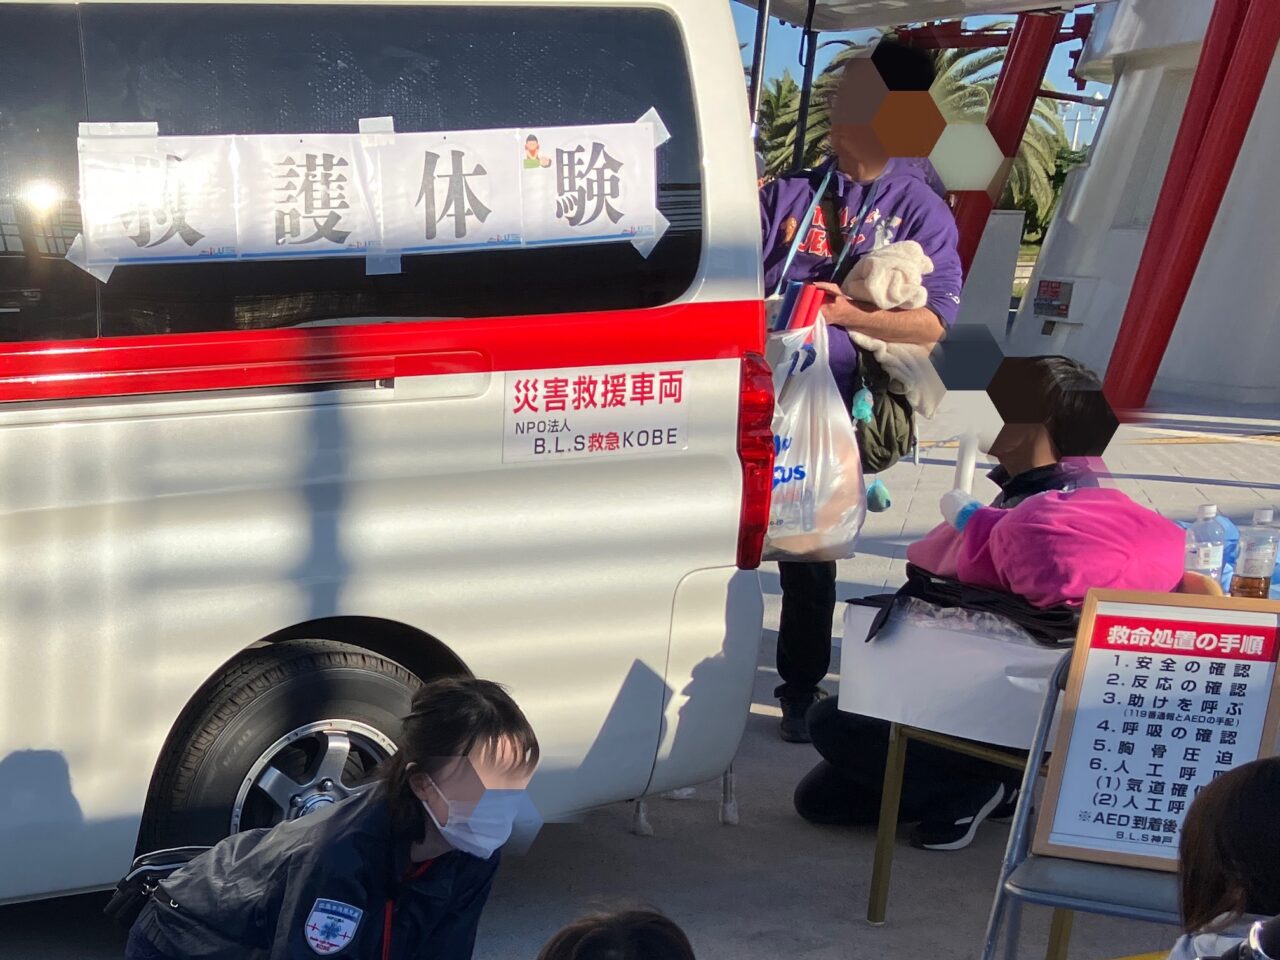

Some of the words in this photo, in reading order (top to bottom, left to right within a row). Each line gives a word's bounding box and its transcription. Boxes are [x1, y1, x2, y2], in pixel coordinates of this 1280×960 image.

[513, 369, 684, 414] 災害救援車両
[515, 418, 572, 435] NPO法人
[534, 427, 678, 455] B.L.S救急KOBE
[1107, 624, 1266, 656] 救命処置の手順
